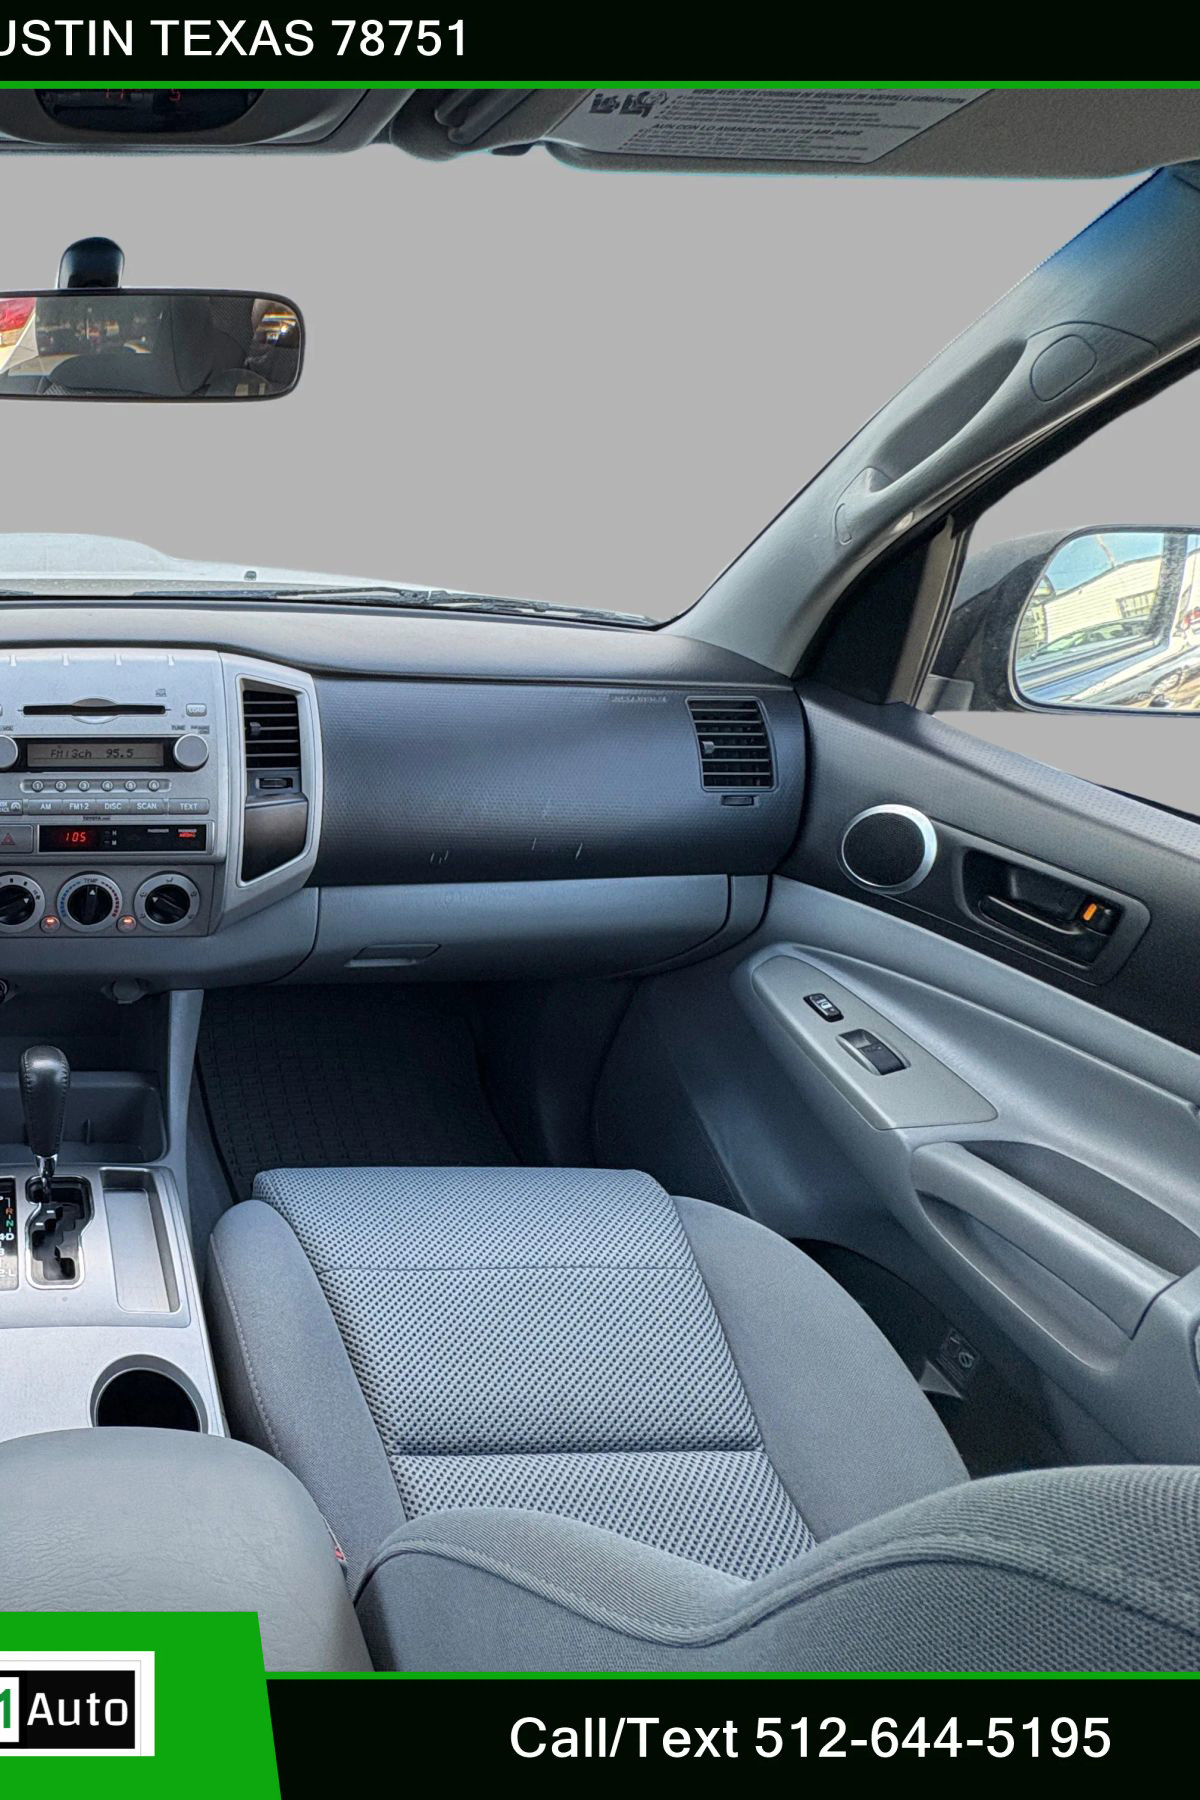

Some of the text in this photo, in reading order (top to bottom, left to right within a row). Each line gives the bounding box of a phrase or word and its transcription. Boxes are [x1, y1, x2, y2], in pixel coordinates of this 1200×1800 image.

[106, 748, 134, 759] 95.5
[137, 802, 157, 810] SCAN
[5, 1207, 14, 1216] R
[6, 1219, 14, 1228] N
